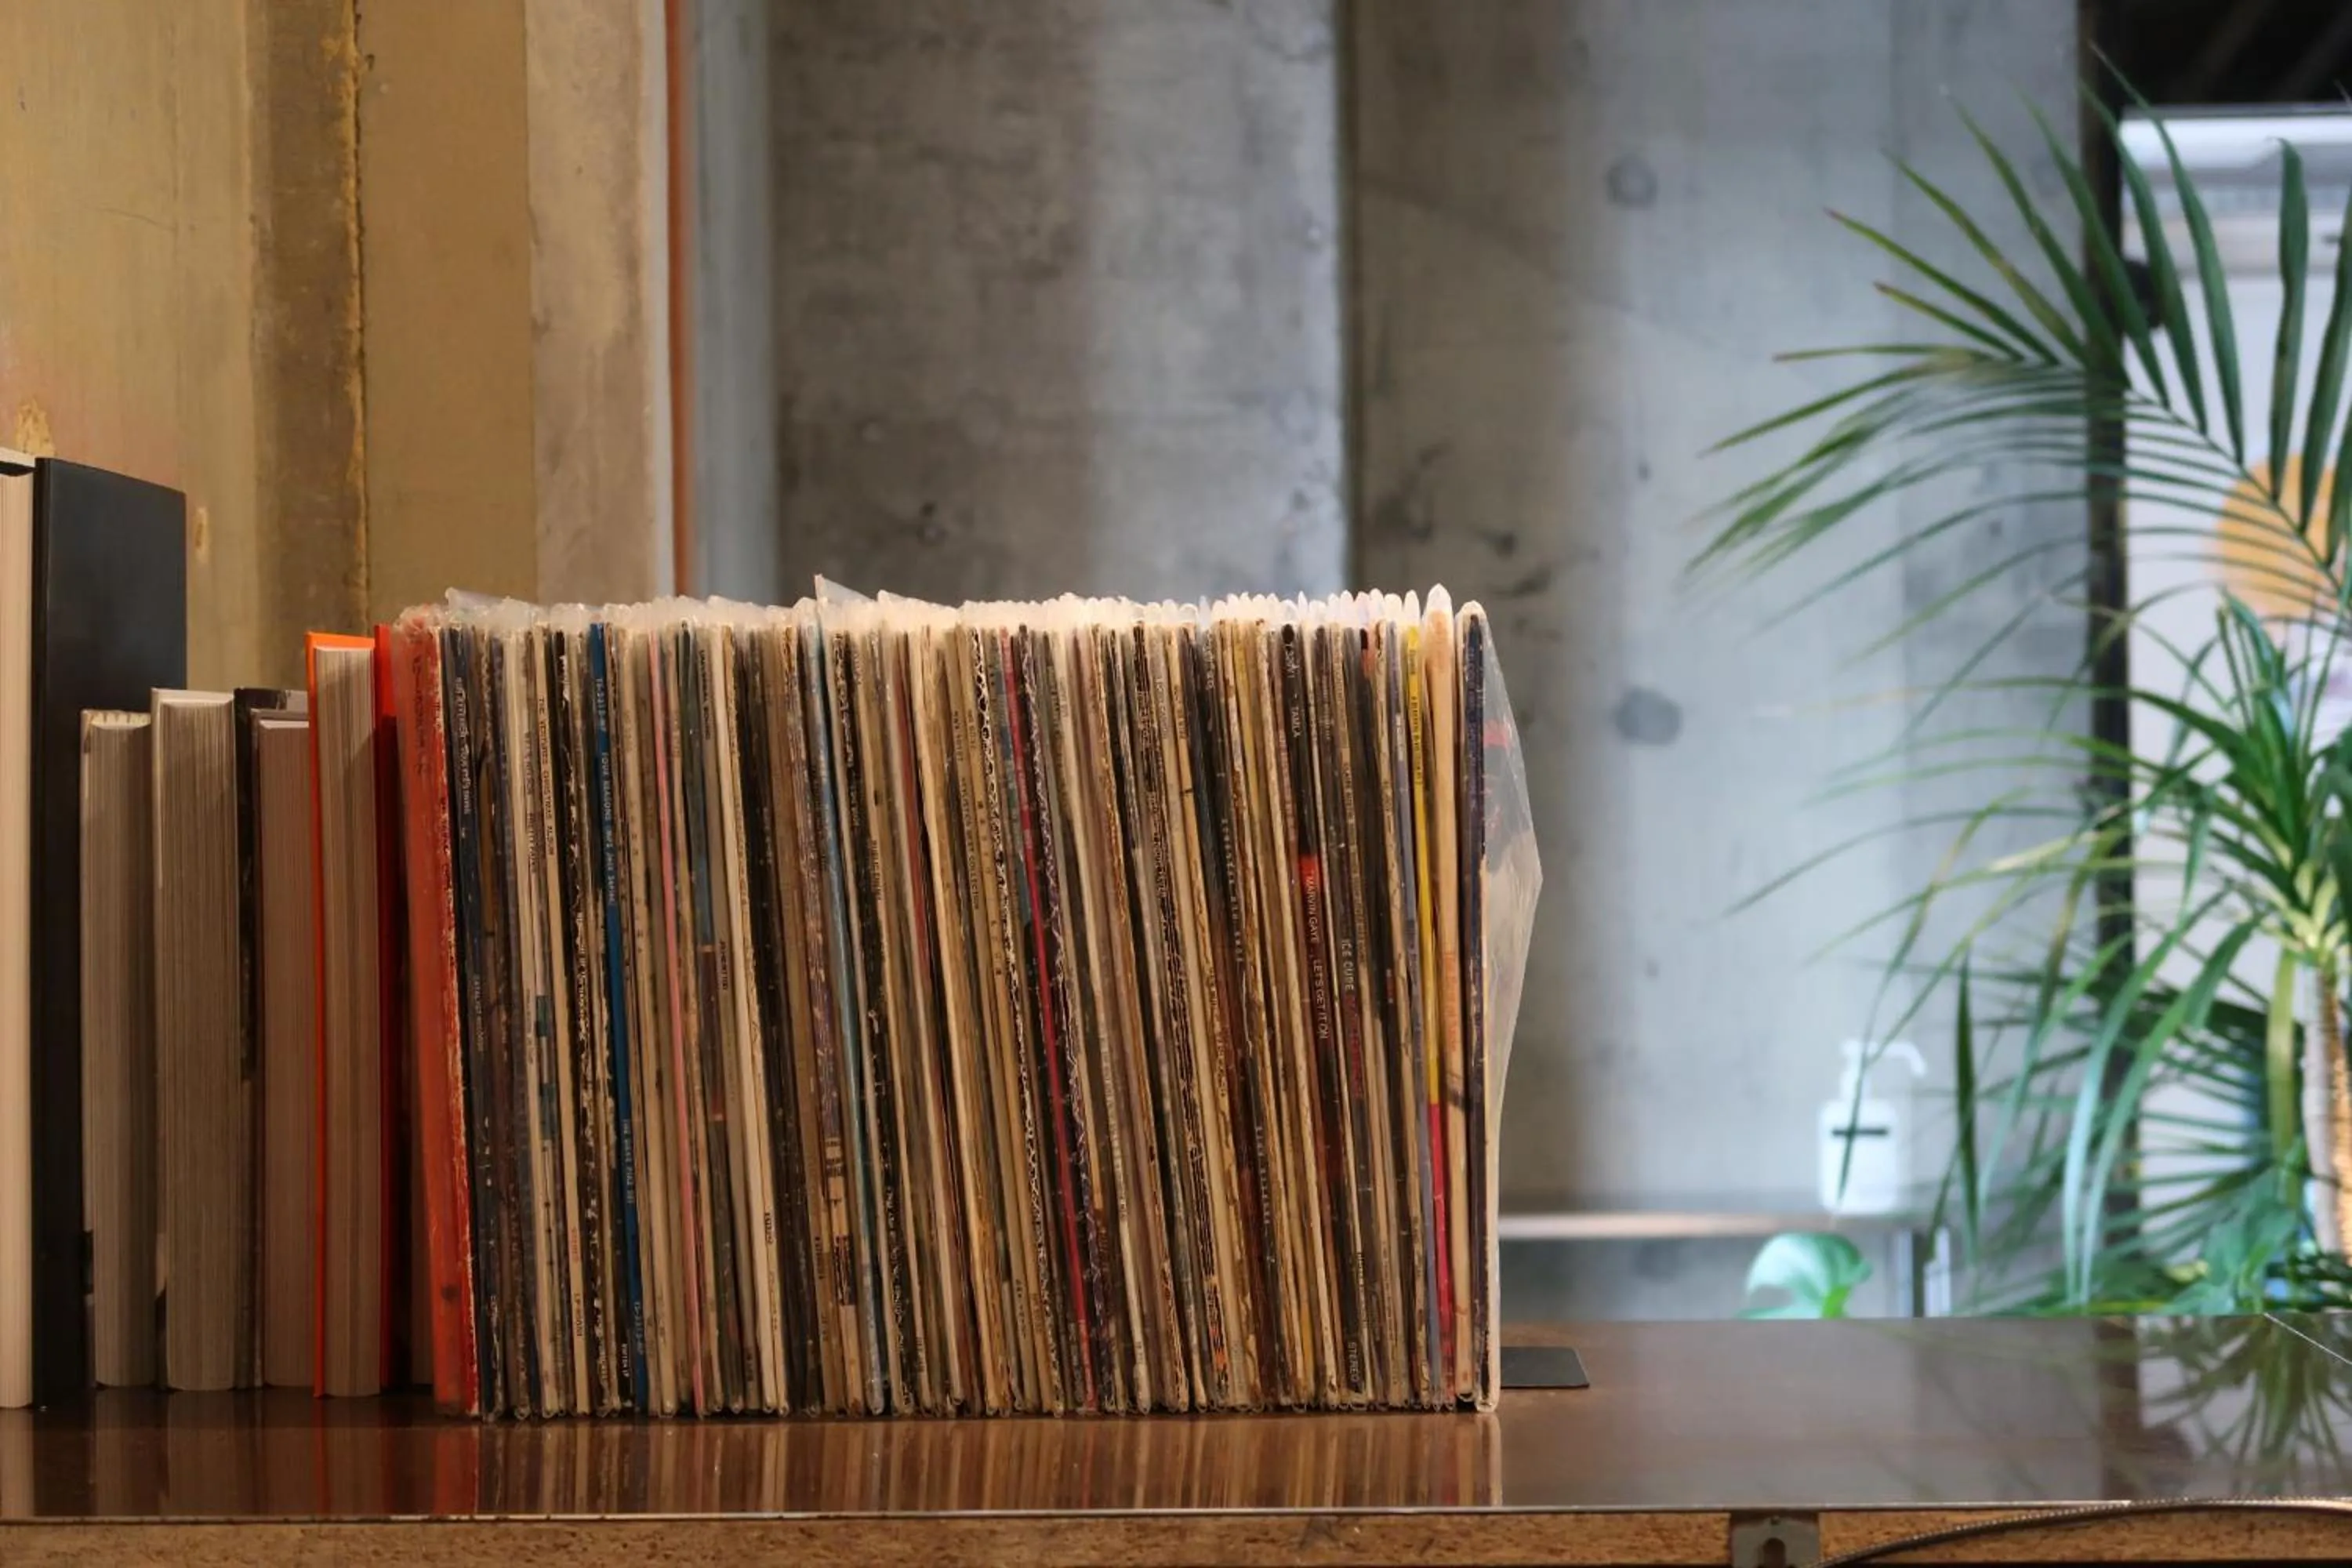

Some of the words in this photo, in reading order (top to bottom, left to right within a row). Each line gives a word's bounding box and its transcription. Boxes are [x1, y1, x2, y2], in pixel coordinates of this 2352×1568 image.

[699, 649, 709, 703] UNIVERSAL
[1291, 706, 1301, 738] TAMLA
[543, 771, 551, 818] CHRISTMAS
[969, 856, 980, 910] COLLECTION
[1306, 876, 1316, 915] MARVIN
[1309, 916, 1319, 943] GAYE
[1341, 939, 1352, 956] ICE
[1344, 961, 1354, 990] CUBE
[1316, 989, 1326, 1011] GET
[1319, 1012, 1327, 1023] IT
[1319, 1024, 1329, 1039] ON
[1348, 1341, 1359, 1383] STEREO
